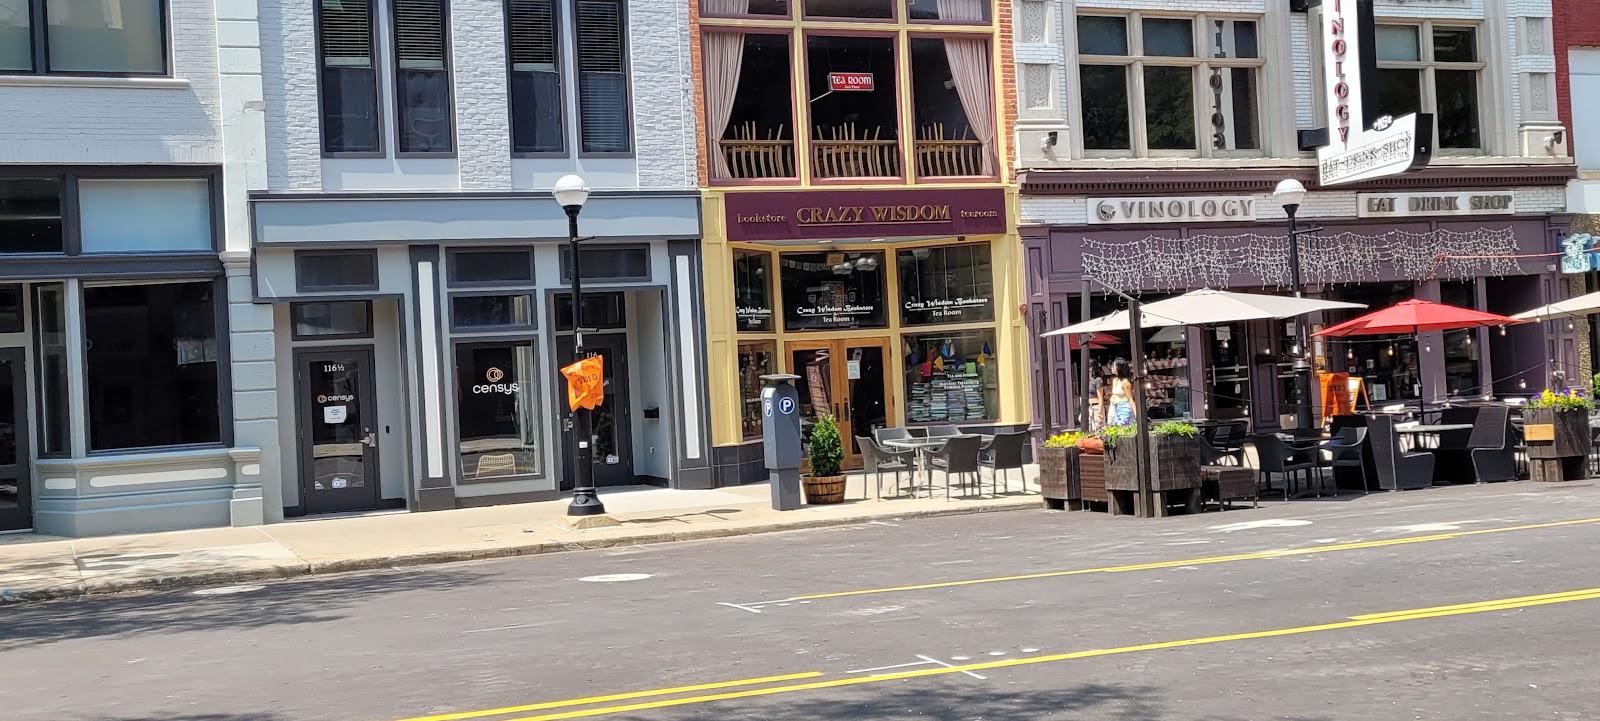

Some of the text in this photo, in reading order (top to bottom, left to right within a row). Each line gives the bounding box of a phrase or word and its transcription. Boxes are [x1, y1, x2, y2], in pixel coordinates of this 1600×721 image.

[831, 75, 871, 85] TEA ROOM
[1120, 200, 1253, 218] VINOLOGY
[1367, 195, 1513, 212] EAT DRINK SHOP
[737, 205, 998, 223] bookstore CRAZY WISDOM tearoom
[817, 304, 842, 313] Wisdom
[843, 304, 873, 312] Bookstore
[905, 301, 925, 309] Crazy
[926, 299, 953, 307] Wisdom
[472, 382, 519, 395] censys
[327, 394, 354, 402] censys
